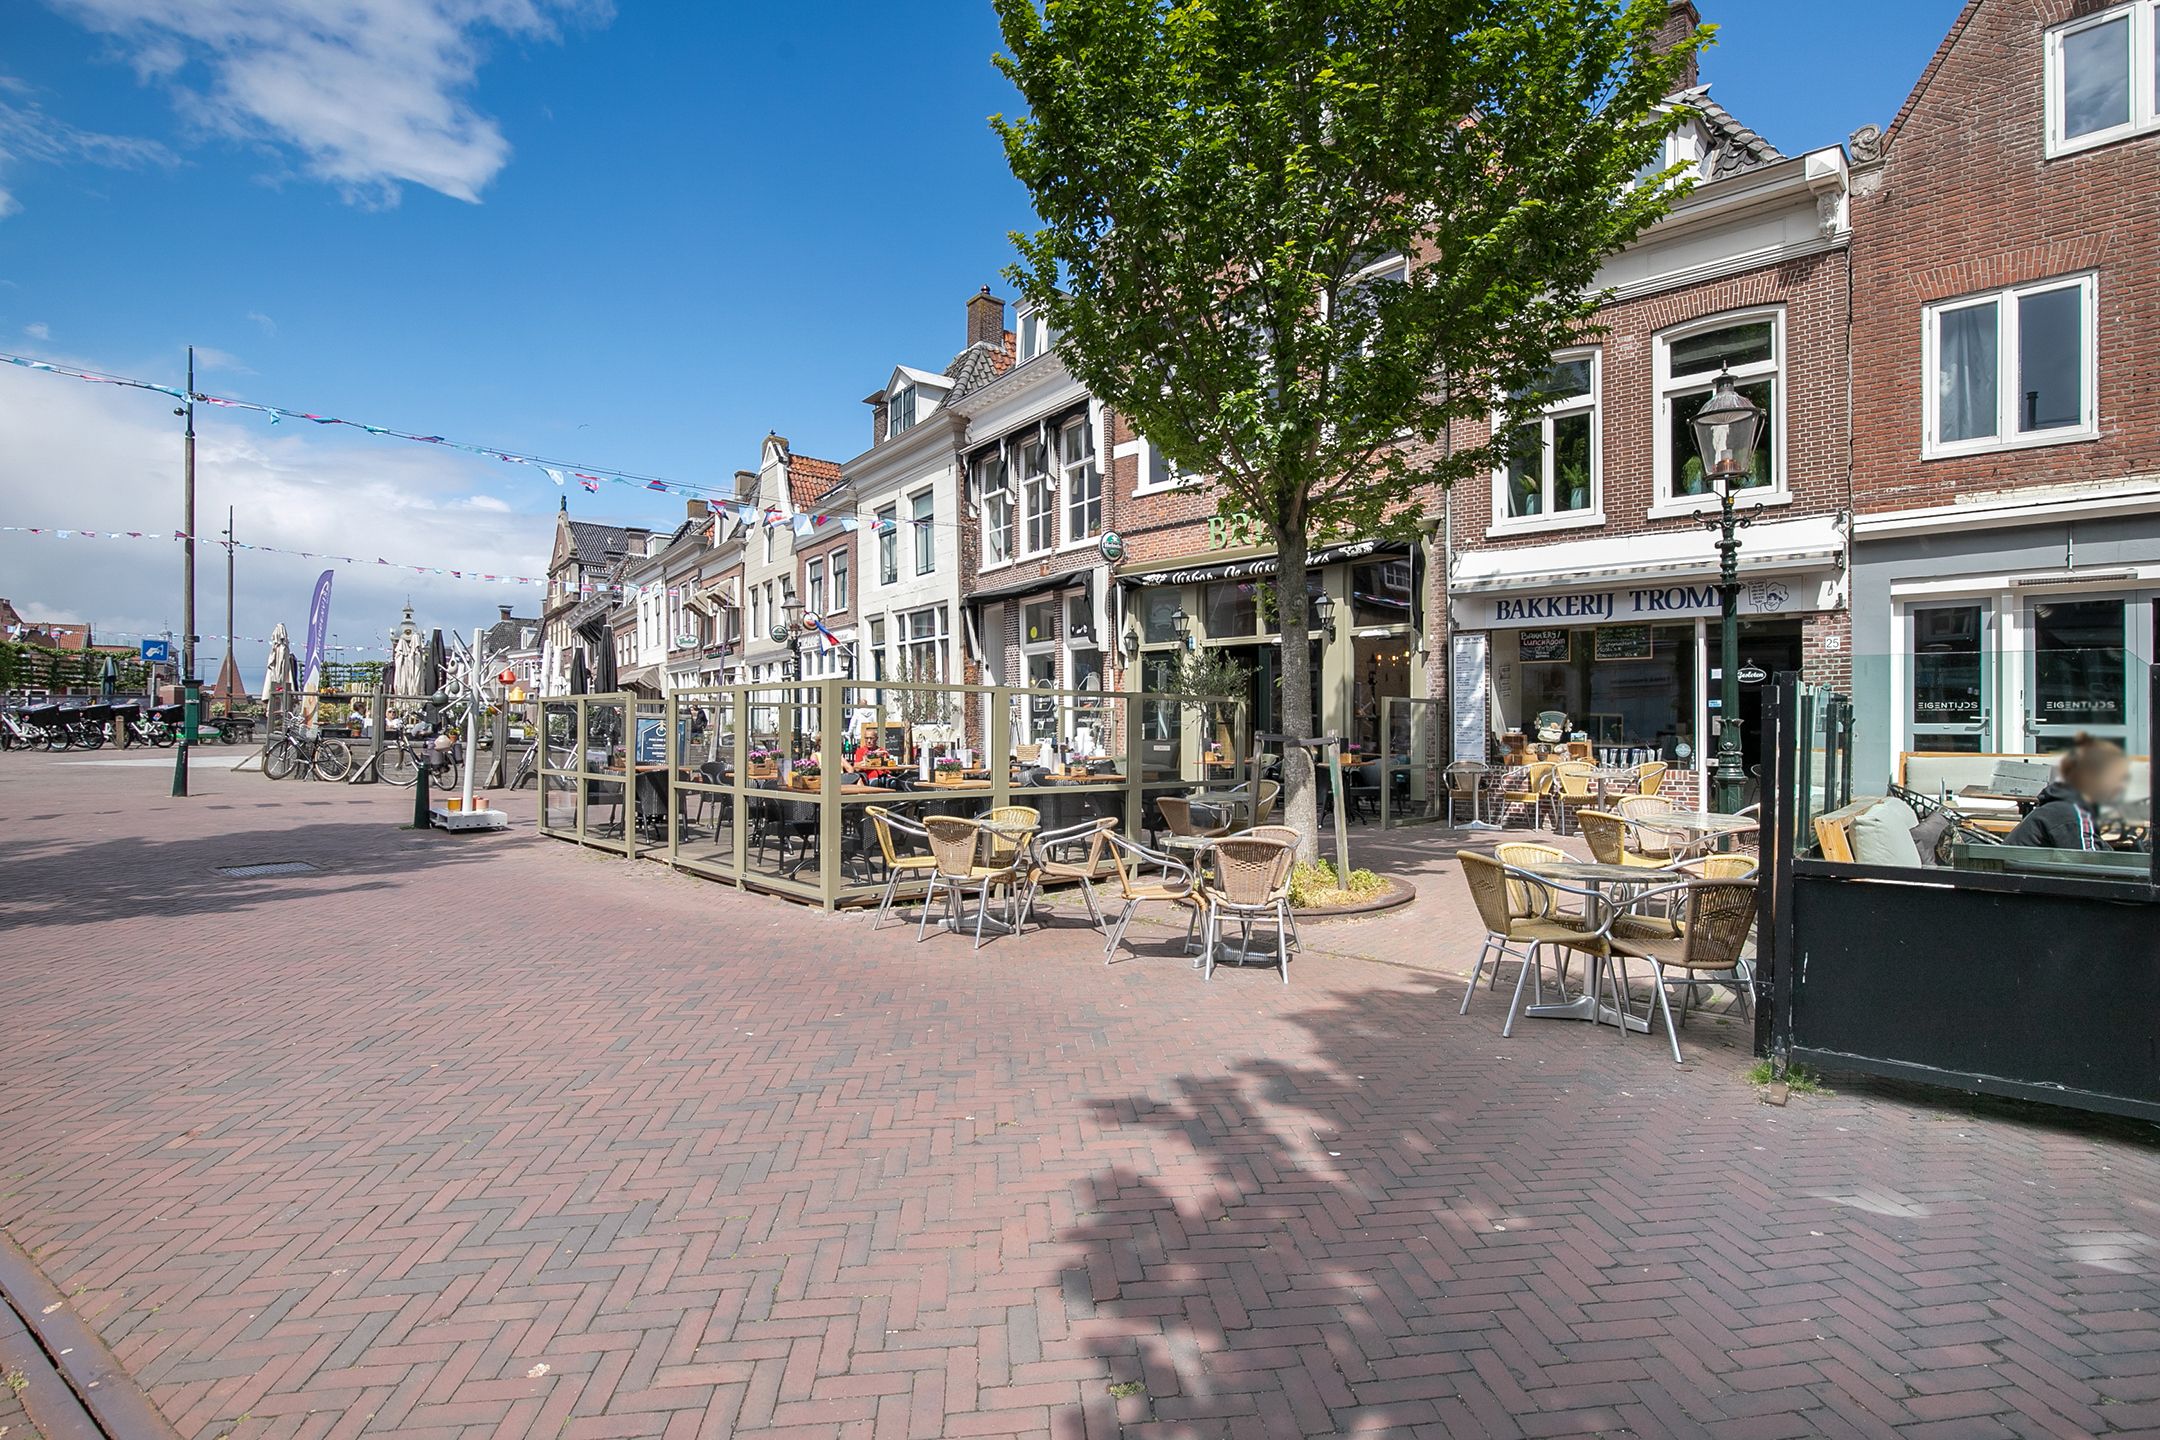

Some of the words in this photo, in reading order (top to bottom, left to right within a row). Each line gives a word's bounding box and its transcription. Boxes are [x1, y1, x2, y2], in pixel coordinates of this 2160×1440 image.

[1495, 592, 1615, 621] BAKKERIJ
[1826, 639, 1839, 648] 25
[1917, 701, 1978, 709] EIGENTIJDS
